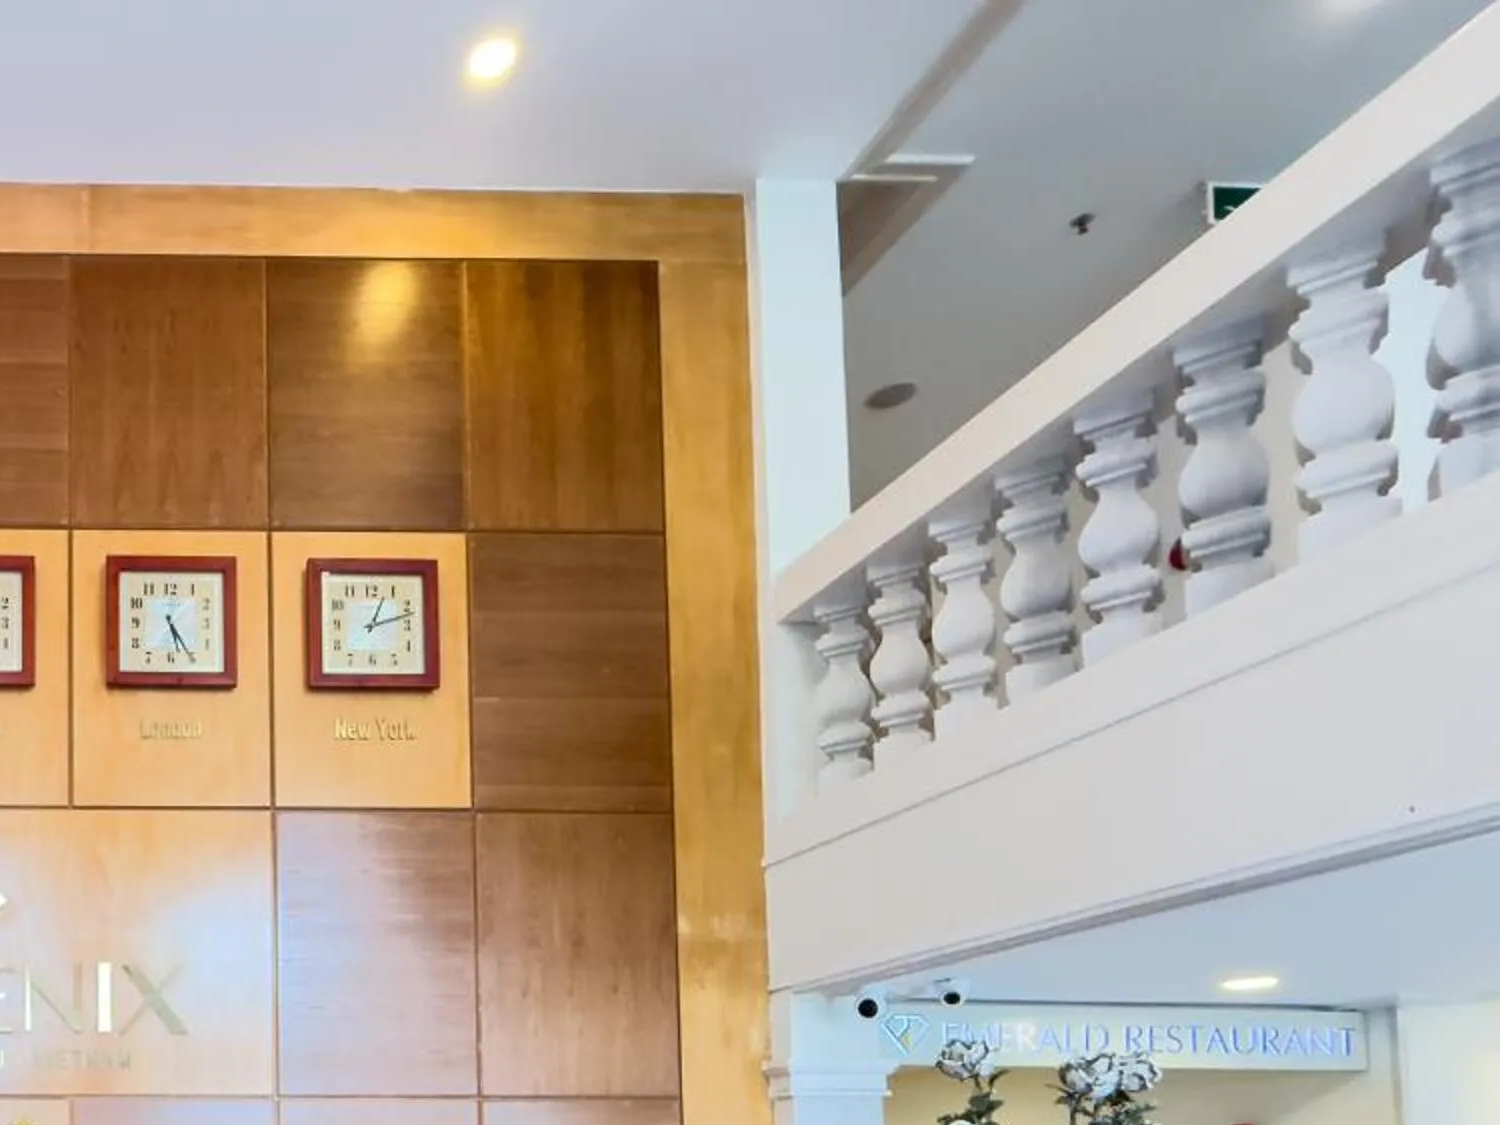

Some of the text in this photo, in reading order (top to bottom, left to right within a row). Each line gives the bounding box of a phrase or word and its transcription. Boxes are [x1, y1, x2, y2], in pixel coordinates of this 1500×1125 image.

[143, 582, 155, 596] 11
[164, 583, 177, 596] 12
[344, 585, 355, 598] 11
[365, 585, 378, 598] 12
[131, 596, 143, 609] 10
[131, 617, 140, 629] 9
[333, 715, 371, 741] New
[941, 1022, 1357, 1057] EMERALD RESTAURANT
